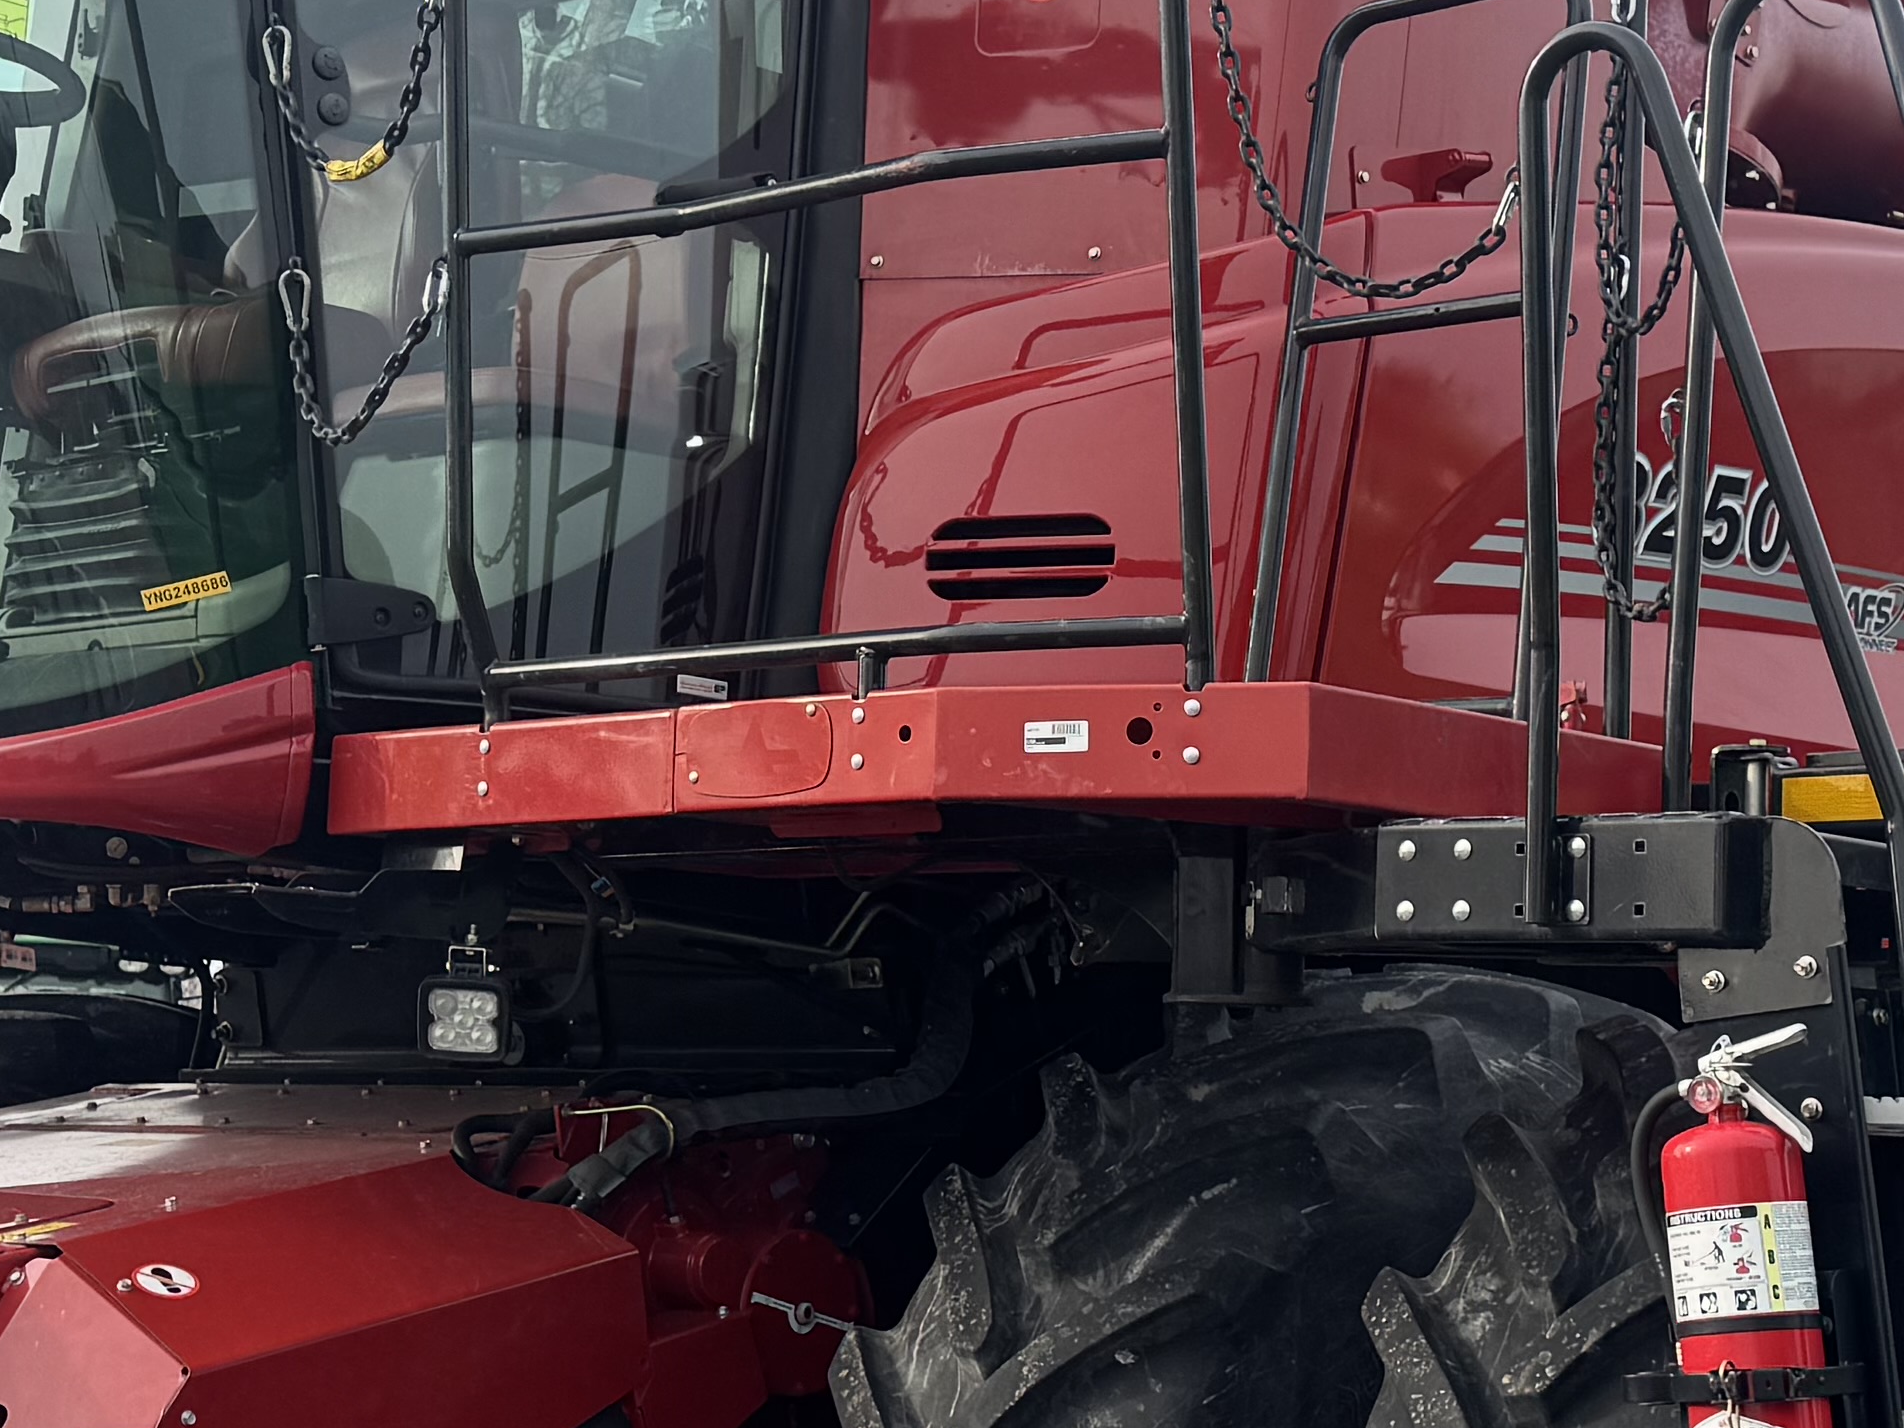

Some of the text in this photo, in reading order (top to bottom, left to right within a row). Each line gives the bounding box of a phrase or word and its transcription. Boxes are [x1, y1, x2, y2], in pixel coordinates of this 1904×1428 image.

[1846, 589, 1895, 633] AFS
[1763, 1214, 1771, 1230] A
[1767, 1249, 1775, 1265] B
[1772, 1284, 1780, 1300] C
